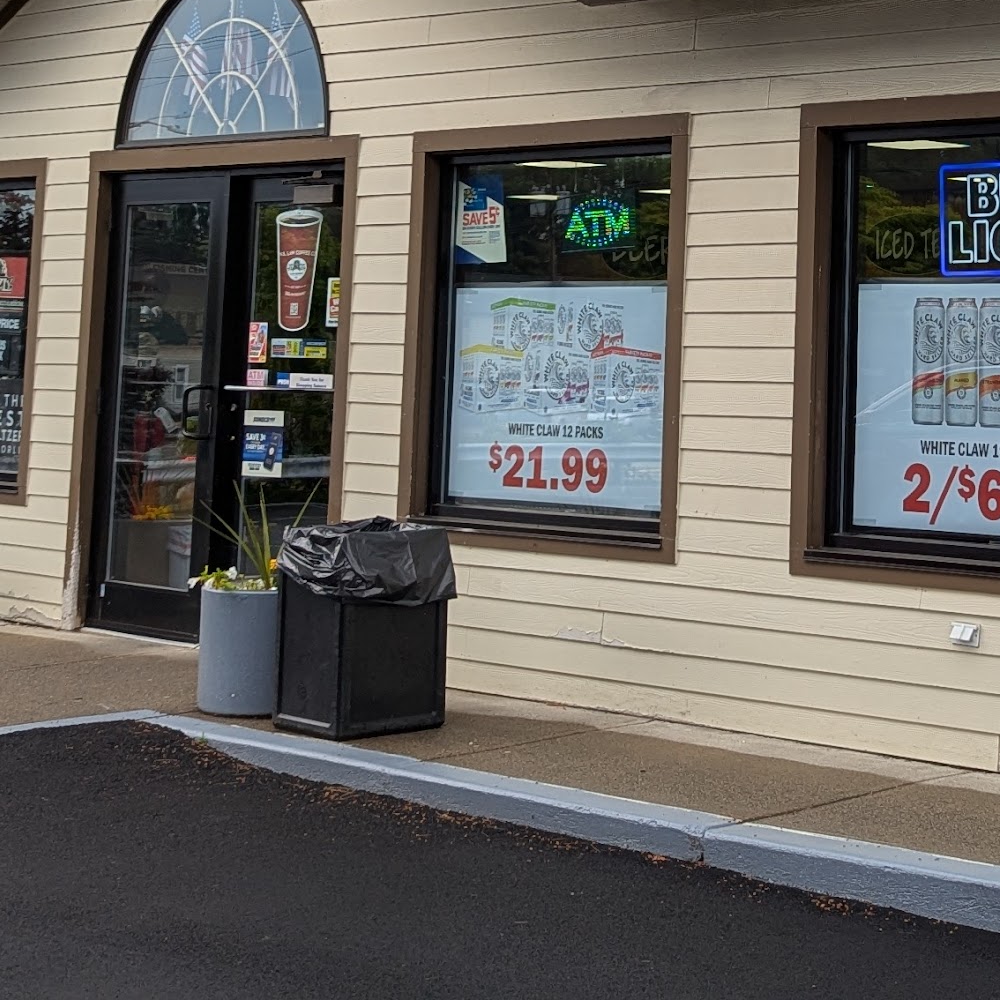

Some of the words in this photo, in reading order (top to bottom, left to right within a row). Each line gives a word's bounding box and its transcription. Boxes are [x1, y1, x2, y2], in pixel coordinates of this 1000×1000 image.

[463, 212, 488, 226] SAVE
[565, 207, 631, 239] ATM
[875, 228, 914, 260] ICED
[920, 228, 940, 260] TE
[508, 423, 535, 436] WHITE
[536, 424, 560, 437] CLAW
[562, 425, 573, 438] 12
[574, 426, 604, 439] PACKS
[920, 440, 956, 456] WHITE
[958, 442, 990, 458] CLAW
[488, 441, 608, 493] $21.99
